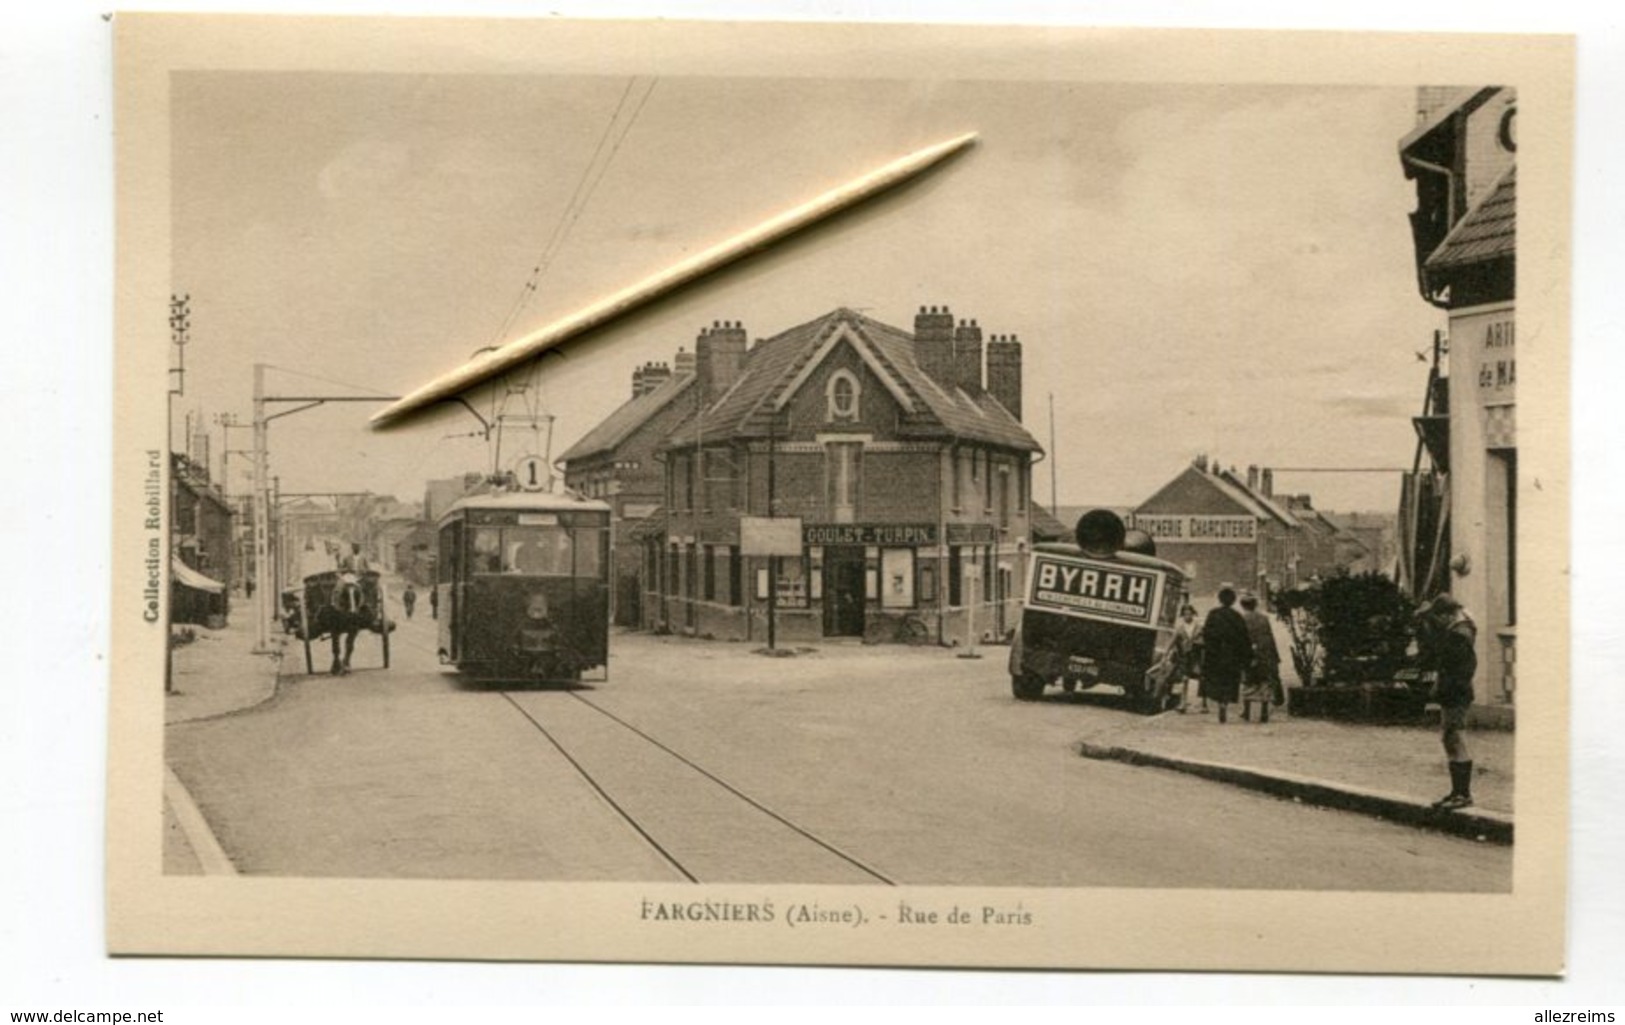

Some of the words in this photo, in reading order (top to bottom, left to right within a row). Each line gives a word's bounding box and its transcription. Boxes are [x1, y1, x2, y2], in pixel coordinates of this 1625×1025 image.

[144, 450, 161, 530] Robillard
[528, 460, 538, 486] 1
[1189, 517, 1254, 538] CHARCUTERIE
[143, 538, 161, 624] Collection
[1038, 562, 1148, 605] BYRRH
[640, 897, 776, 922] FARGNIERS
[785, 902, 870, 929] (Aisne).
[898, 901, 939, 926] Rue
[946, 904, 971, 926] de
[981, 902, 1034, 927] Paris
